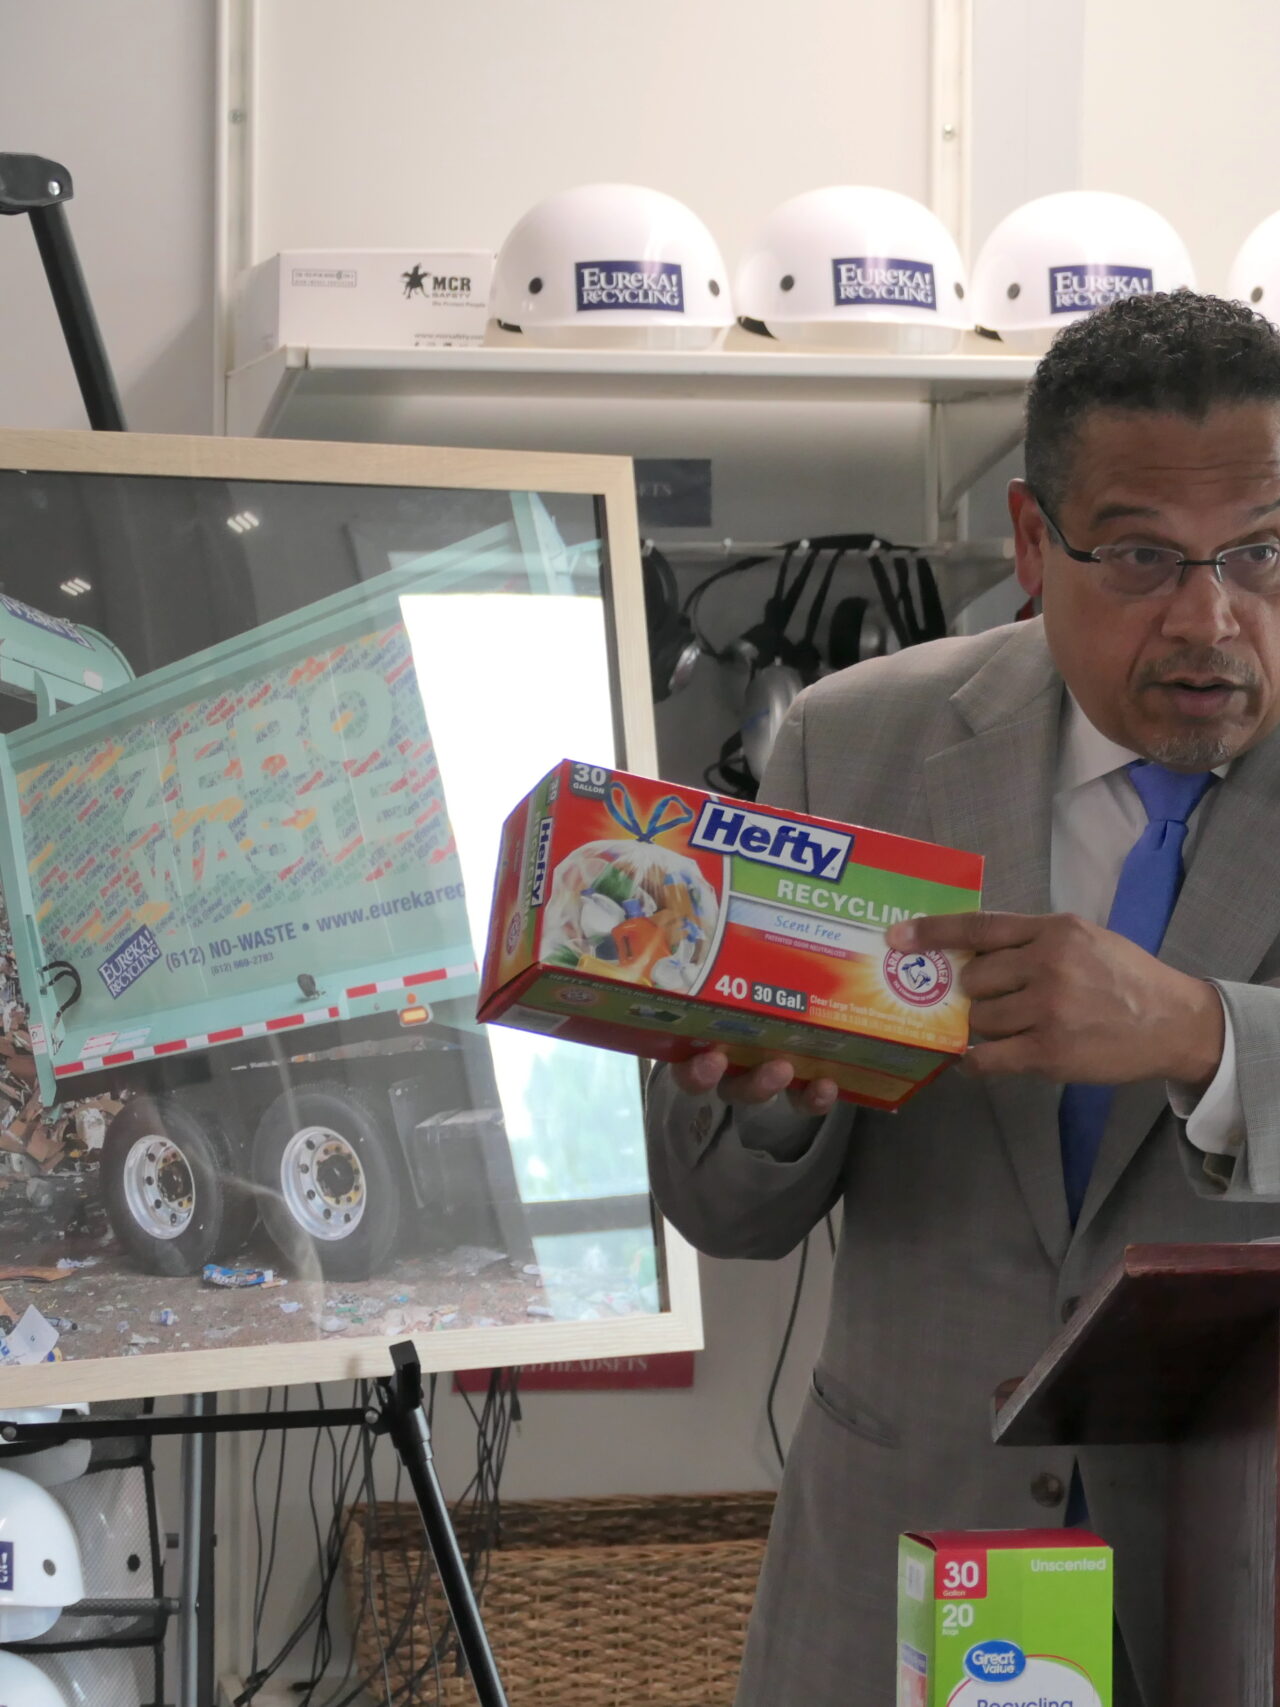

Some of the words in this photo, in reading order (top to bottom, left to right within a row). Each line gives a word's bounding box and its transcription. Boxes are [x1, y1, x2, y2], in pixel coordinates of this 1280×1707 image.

[433, 276, 471, 292] MCR
[117, 671, 393, 827] ZERO
[572, 781, 605, 794] GALLON
[573, 763, 607, 786] 30
[130, 765, 422, 902] WASTE
[702, 807, 842, 876] Hefty
[531, 822, 550, 901] Hefty
[777, 879, 929, 923] RECYCLIN
[774, 915, 810, 934] Scent
[814, 923, 842, 941] Free
[166, 946, 206, 973] (612)
[209, 922, 297, 959] NO-WASTE
[715, 975, 748, 999] 40
[754, 985, 772, 1002] 30
[776, 990, 805, 1010] Gal.
[943, 1561, 979, 1588] 30
[1031, 1558, 1107, 1573] Unscented
[942, 1603, 974, 1628] 20
[971, 1650, 1016, 1666] Great
[982, 1659, 1016, 1674] Value
